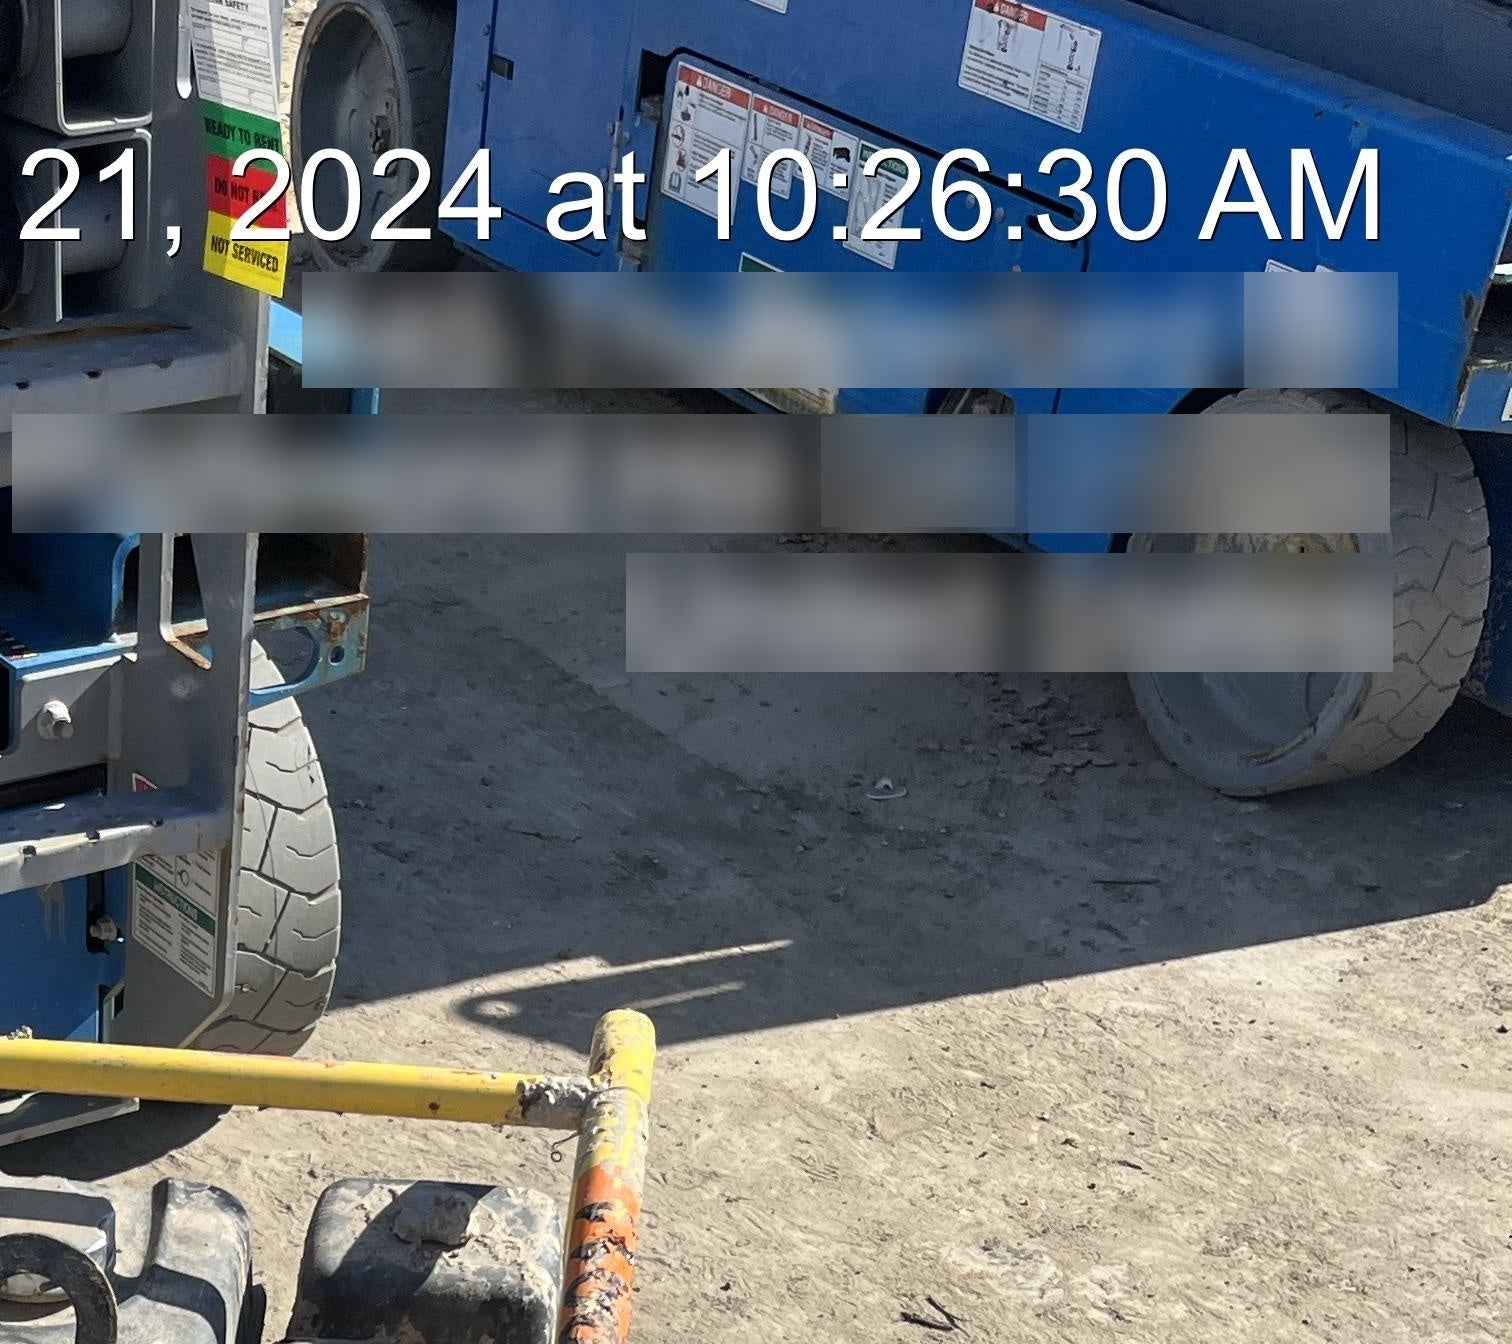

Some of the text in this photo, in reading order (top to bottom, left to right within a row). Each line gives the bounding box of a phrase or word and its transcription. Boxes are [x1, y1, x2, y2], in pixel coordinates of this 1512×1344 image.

[204, 117, 279, 152] READY TO RENT
[214, 177, 227, 196] DO
[231, 182, 249, 203] NOT
[210, 235, 279, 273] NOT SERVICED
